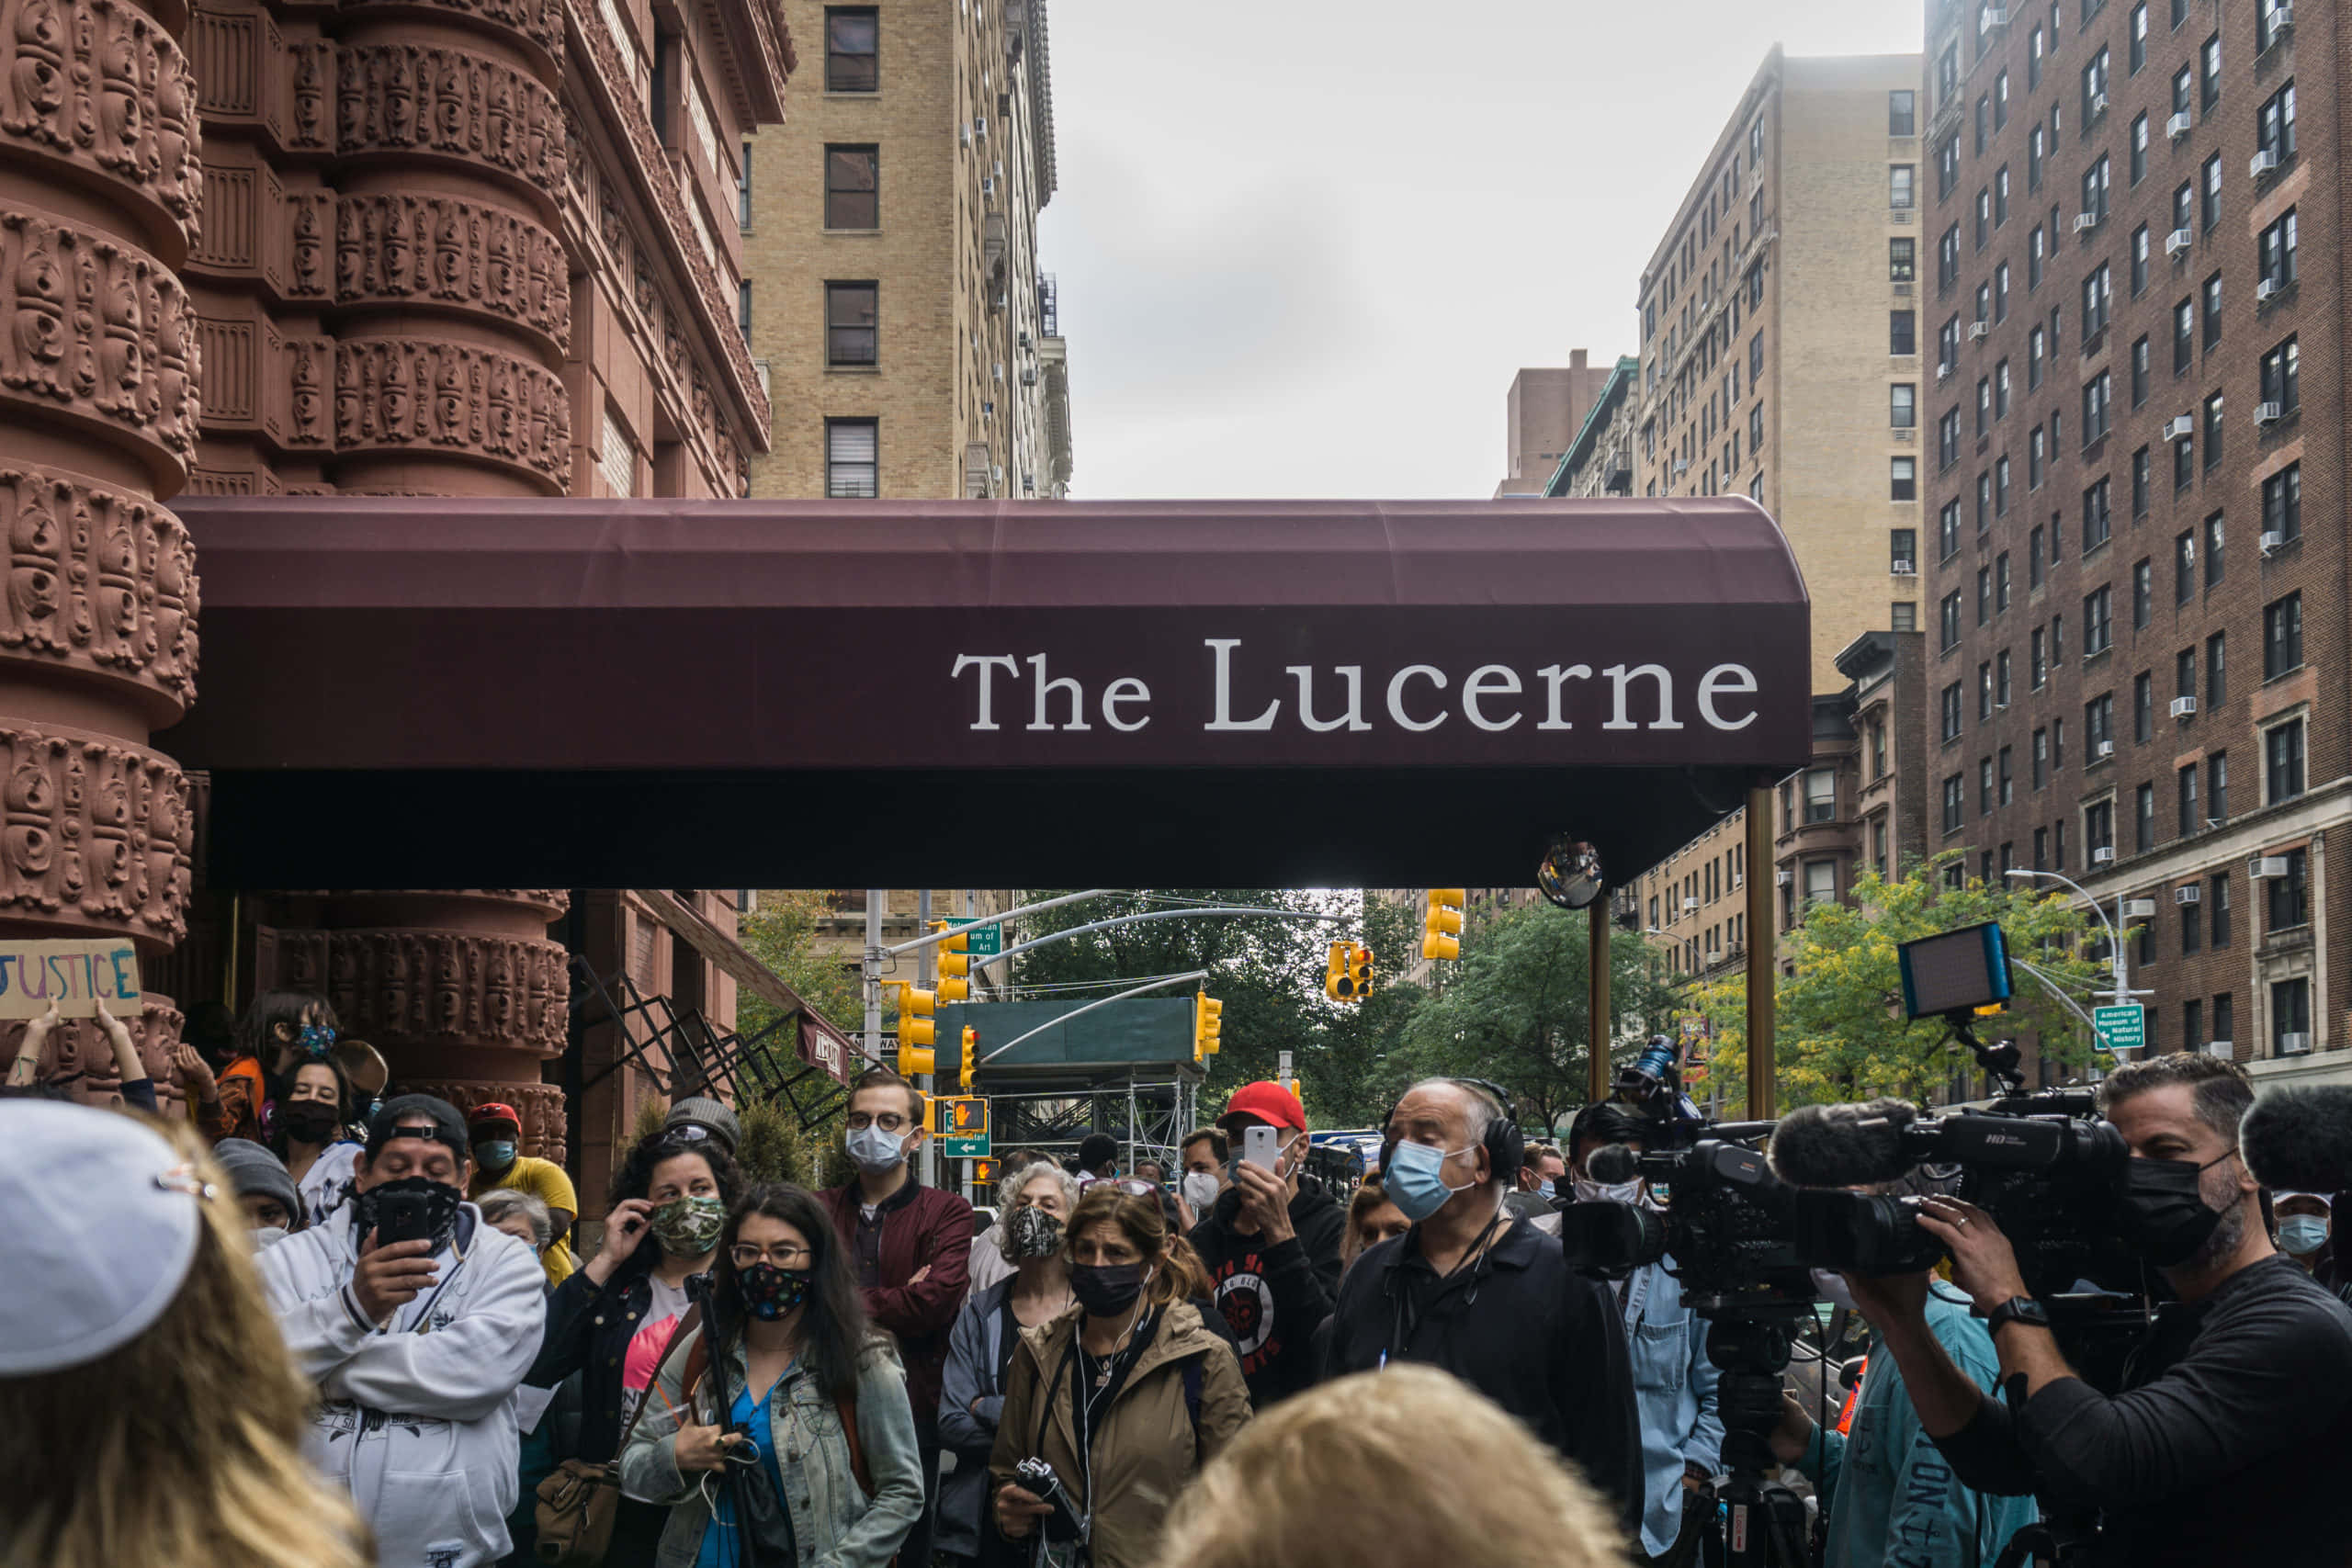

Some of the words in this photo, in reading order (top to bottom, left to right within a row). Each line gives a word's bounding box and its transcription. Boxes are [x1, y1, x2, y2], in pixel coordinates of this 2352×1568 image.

[951, 652, 1151, 733] The
[1204, 637, 1759, 733] Lucerne
[985, 932, 994, 941] of
[978, 942, 991, 952] Art
[0, 950, 139, 1000] JUSTICE
[2101, 1010, 2138, 1019] American
[2098, 1019, 2129, 1027] Museum
[2111, 1025, 2141, 1033] Natural
[2113, 1034, 2141, 1043] History
